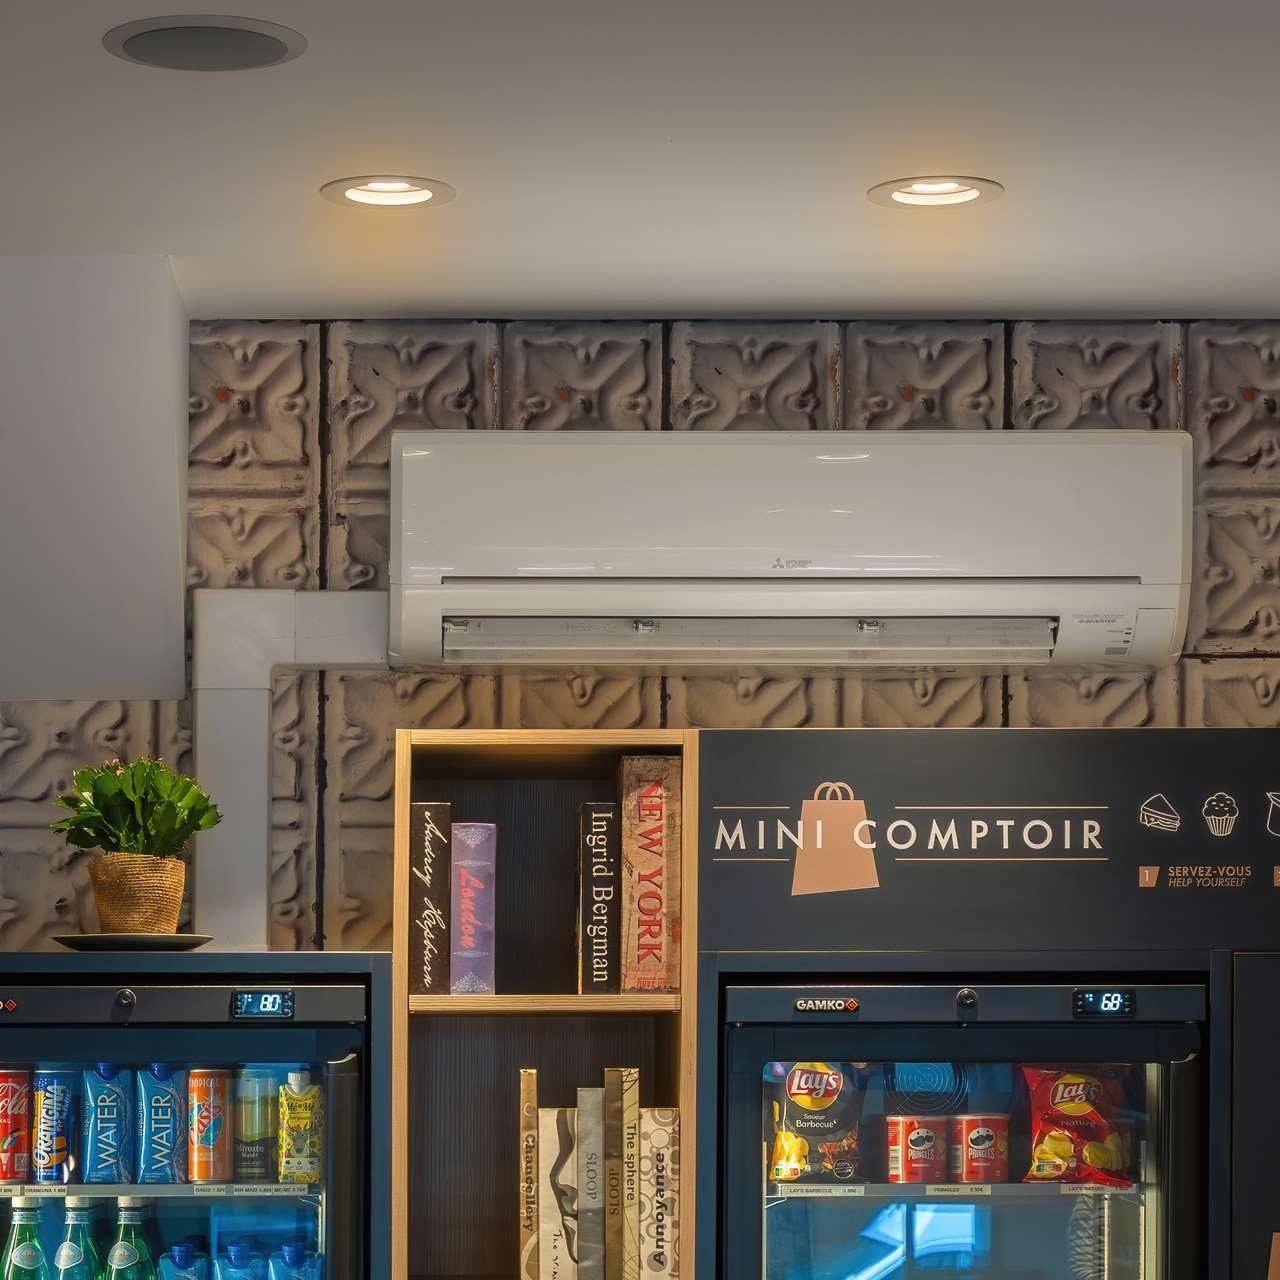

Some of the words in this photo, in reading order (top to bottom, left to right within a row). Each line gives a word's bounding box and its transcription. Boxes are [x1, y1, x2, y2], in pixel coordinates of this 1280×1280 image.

[637, 775, 665, 858] NEW
[714, 818, 824, 850] MINI
[853, 818, 1105, 850] COMPTOIR
[412, 811, 447, 888] Audrey
[586, 811, 613, 876] Ingrid
[1144, 870, 1151, 882] 1
[1168, 866, 1252, 877] SERVEZ-VOUS
[1168, 877, 1194, 886] HELP
[1196, 877, 1246, 886] YOURSELF
[458, 868, 486, 949] London
[637, 867, 664, 964] YORK
[416, 896, 446, 988] Hepburn
[587, 886, 614, 982] Bergman
[796, 1000, 845, 1010] GAMKO
[790, 1070, 839, 1098] Lay's
[1054, 1084, 1099, 1104] Lay's
[32, 1086, 67, 1165] ORANGINA
[96, 1092, 117, 1168] WATER
[152, 1094, 171, 1170] WATER
[626, 1123, 637, 1150] The
[586, 1152, 597, 1200] SLOOP
[624, 1154, 637, 1200] sphere
[908, 1148, 934, 1160] PRINGLES
[968, 1148, 995, 1160] PRINGLES
[608, 1168, 619, 1216] SLOOP
[653, 1152, 665, 1266] Annoyance
